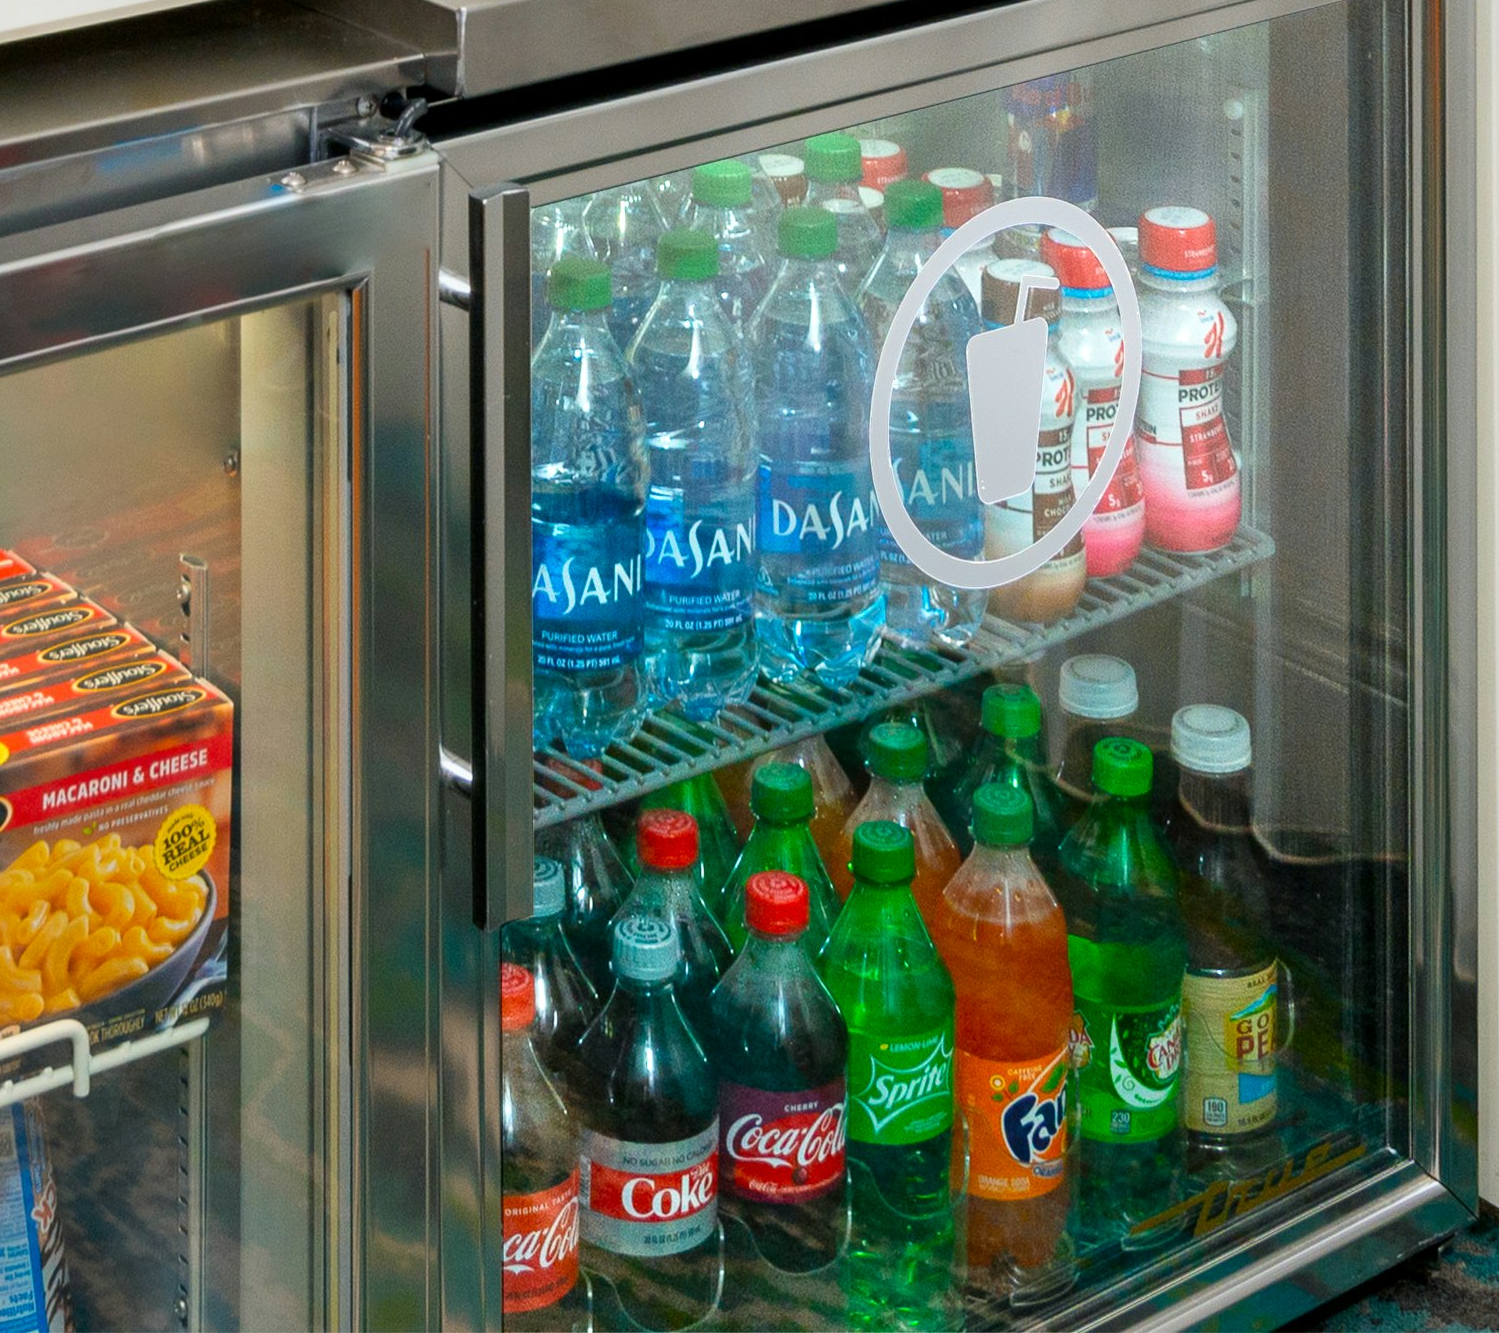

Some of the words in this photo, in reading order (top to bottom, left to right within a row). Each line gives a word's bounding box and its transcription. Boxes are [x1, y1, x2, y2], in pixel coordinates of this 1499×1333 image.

[668, 592, 712, 607] PURIFIED
[713, 589, 743, 604] WATER
[12, 608, 84, 633] Stouffer's
[47, 634, 122, 661] Stouffer's
[541, 630, 585, 644] PURIFIED
[586, 629, 619, 643] WATER
[83, 662, 157, 689] Stouffer's
[121, 690, 198, 716] Stouffer's
[41, 771, 129, 812] MACARONI
[132, 768, 146, 785] &
[148, 747, 209, 780] CHEESE
[32, 819, 59, 836] freshly
[60, 815, 82, 829] made
[82, 810, 105, 826] pasta
[119, 800, 135, 812] real
[136, 792, 166, 809] cheddar
[167, 785, 193, 801] cheese
[193, 779, 216, 792] sauce
[98, 822, 110, 833] NO
[110, 805, 169, 830] PRESERVATIVES
[163, 815, 206, 850] 100%
[162, 829, 210, 867] REAL
[169, 844, 210, 874] CHEESE
[100, 1015, 146, 1043] THOROUGHLY
[1006, 1064, 1042, 1077] CAFFEINE
[1018, 1073, 1037, 1083] FREE
[867, 1061, 946, 1110] Sprite
[783, 1100, 819, 1113] CHERRY
[1111, 1112, 1130, 1123] 230
[1206, 1100, 1225, 1114] 190
[622, 1155, 638, 1166] NO
[638, 1156, 671, 1167] SUGAR
[620, 1170, 715, 1220] Coke
[504, 1201, 550, 1217] ORIGINAL
